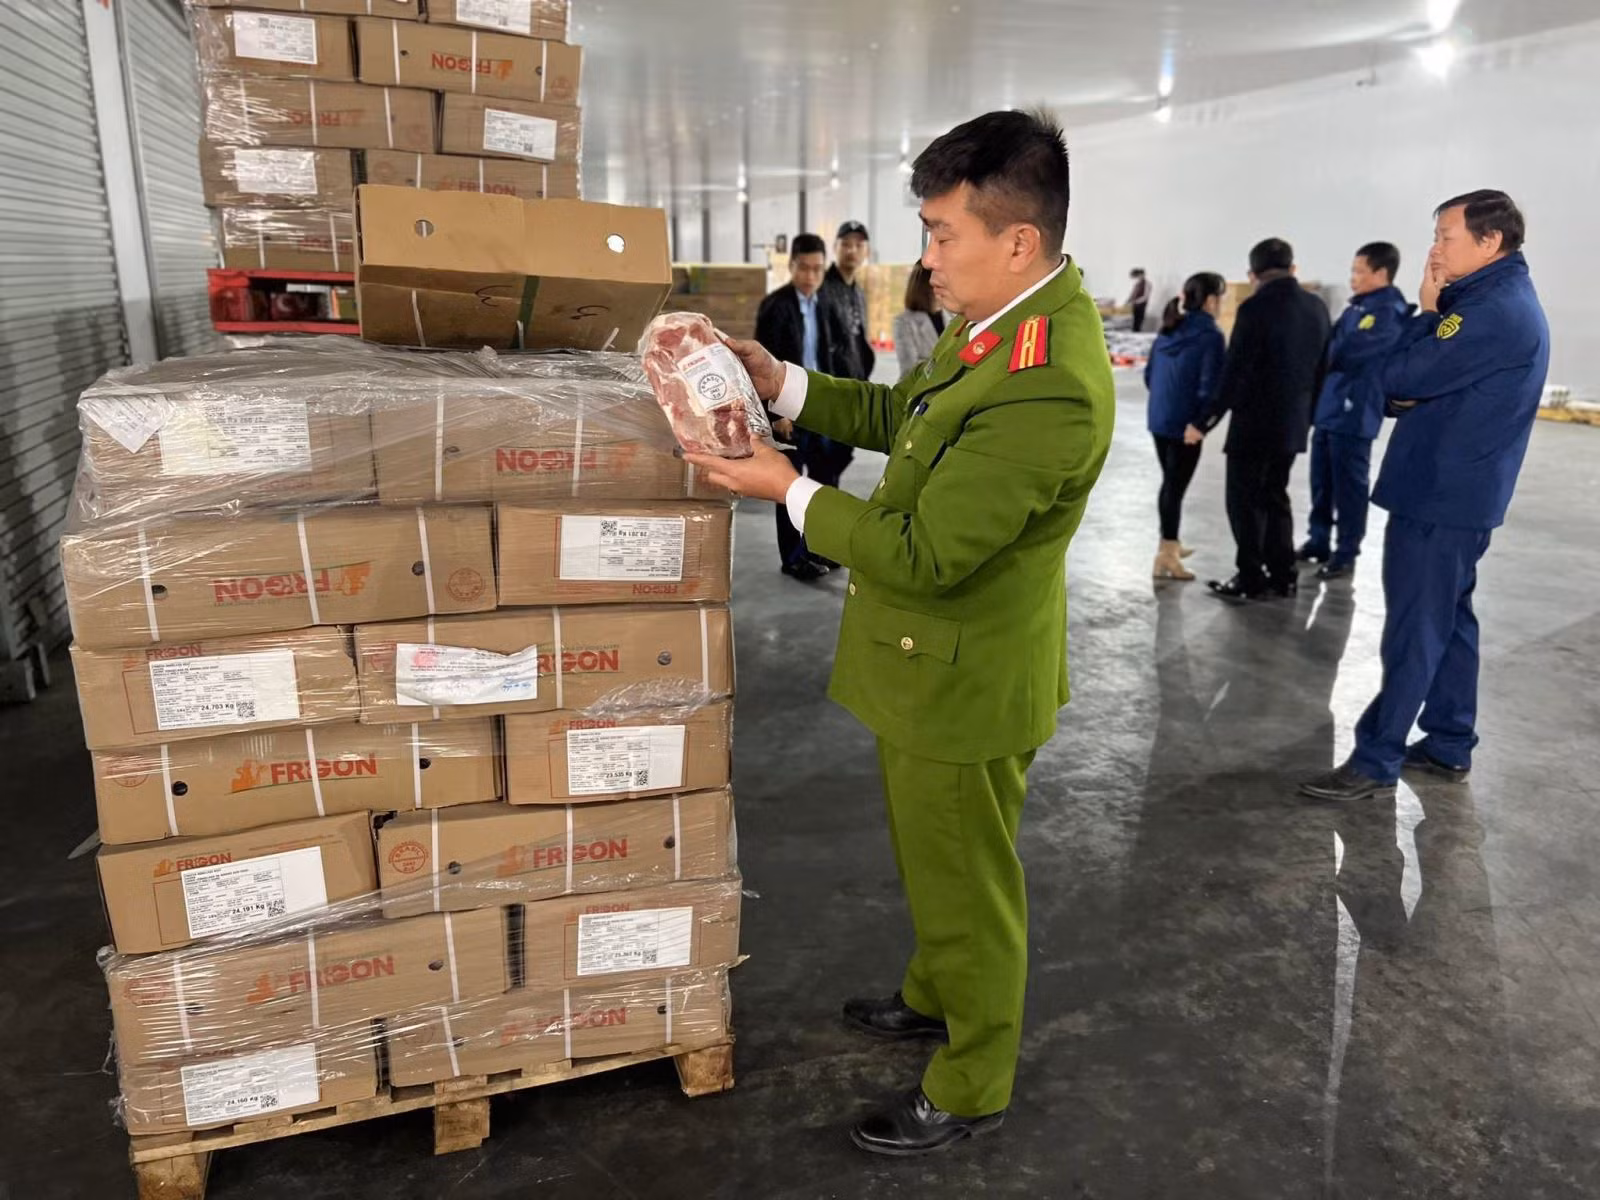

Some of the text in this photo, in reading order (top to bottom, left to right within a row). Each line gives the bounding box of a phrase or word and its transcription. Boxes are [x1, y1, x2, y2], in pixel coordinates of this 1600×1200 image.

[211, 569, 331, 603] FRIGON
[225, 703, 235, 711] Kg
[270, 752, 378, 785] FRIGON
[176, 852, 232, 871] FRIGON
[255, 903, 265, 911] Kg
